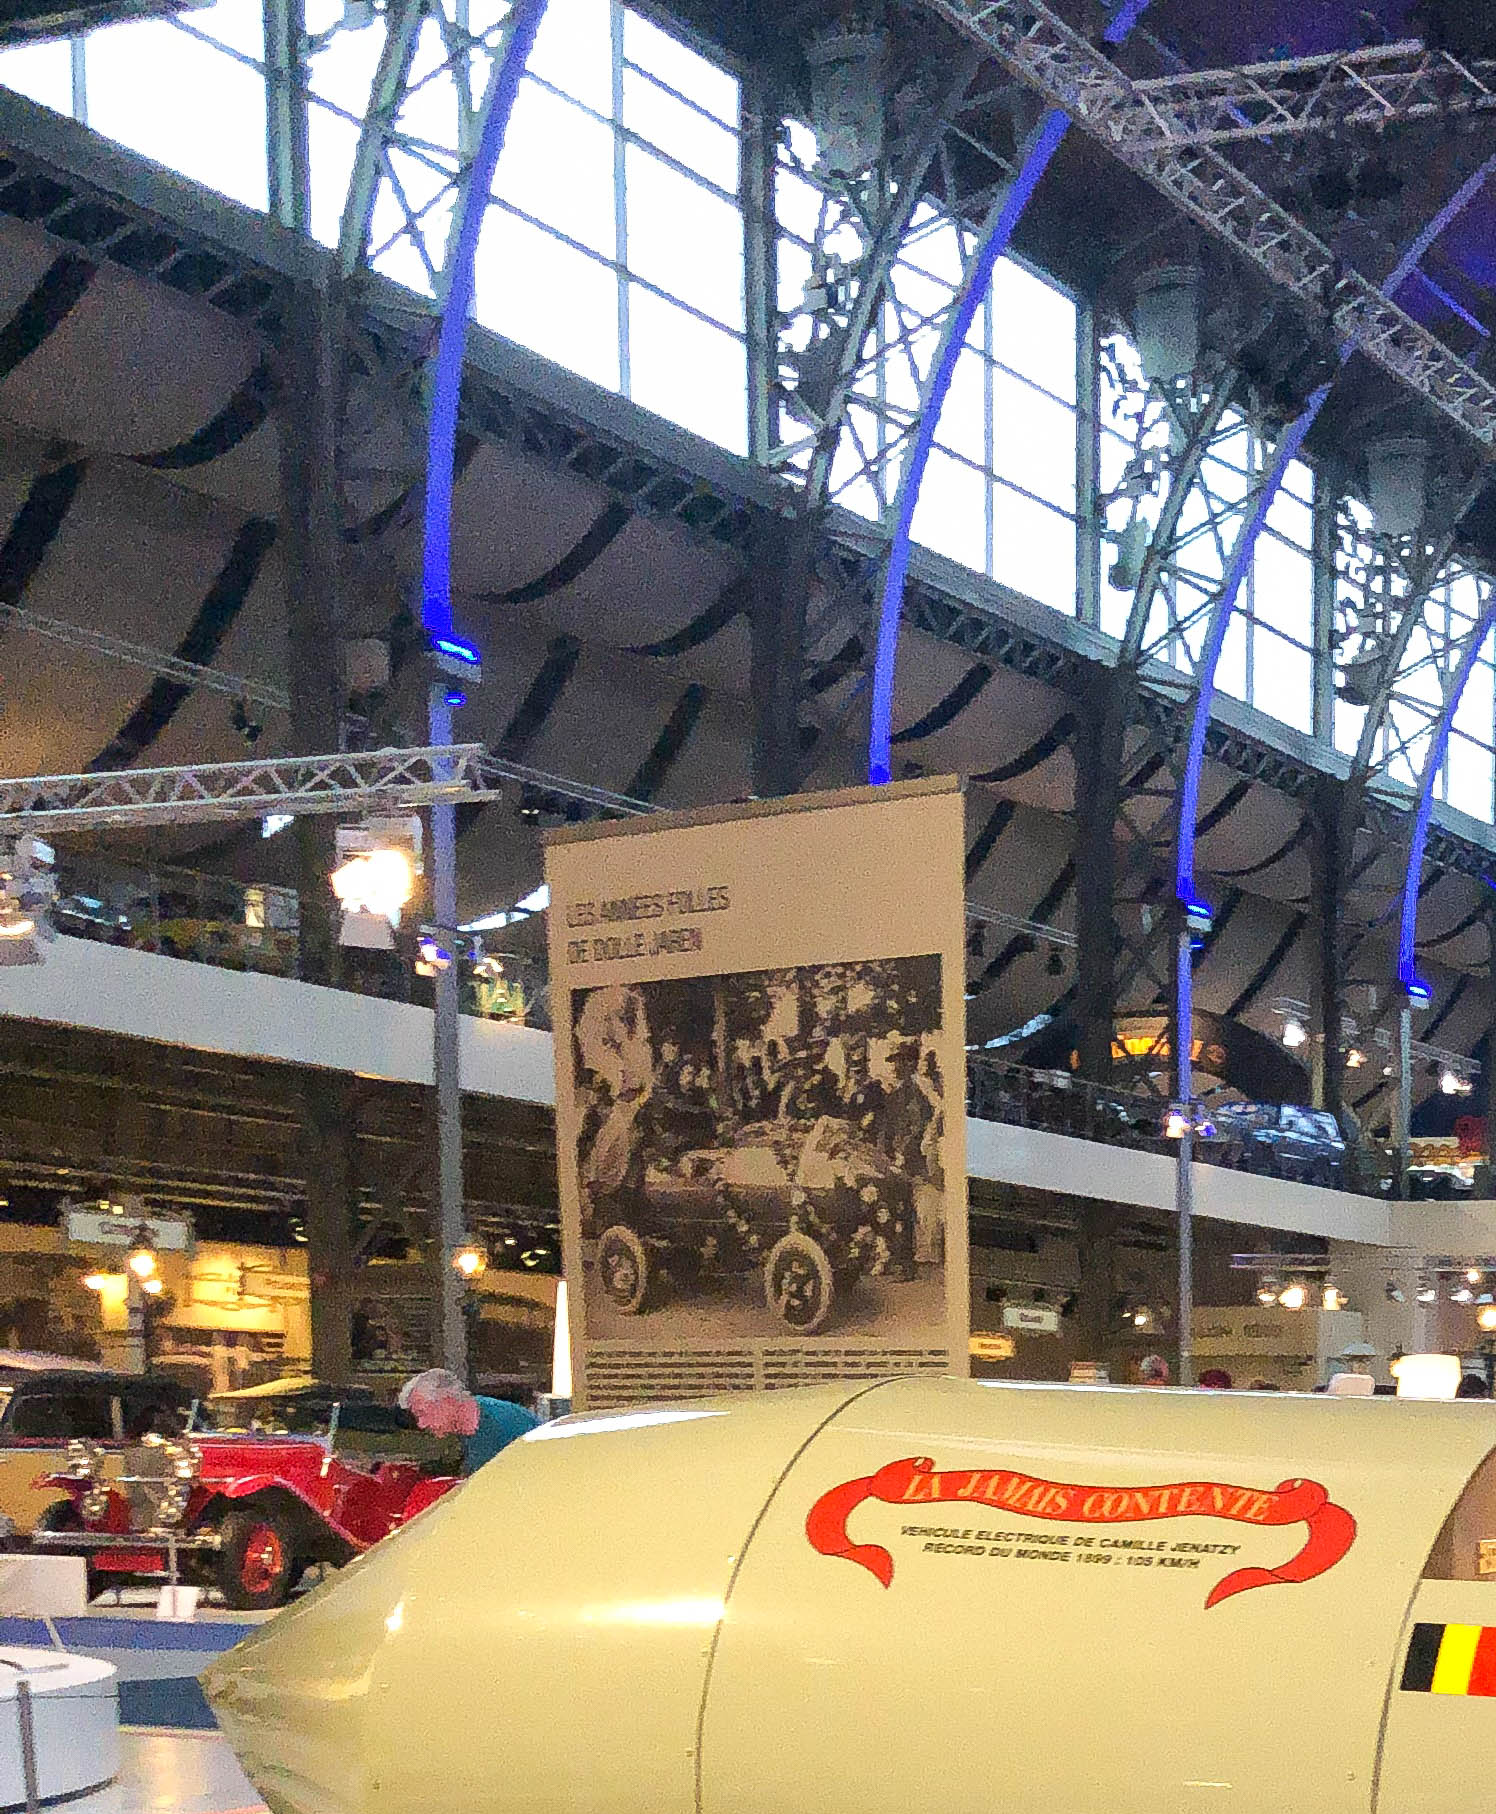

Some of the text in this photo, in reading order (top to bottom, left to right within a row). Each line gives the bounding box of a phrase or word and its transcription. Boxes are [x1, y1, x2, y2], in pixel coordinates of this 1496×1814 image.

[567, 902, 597, 928] LES
[668, 885, 731, 914] FOLLES
[567, 926, 703, 964] DE DOLLE JAREN
[903, 1472, 1280, 1521] LA JAMAIS CONTENTE
[901, 1525, 1242, 1555] VEHICULE ELECTRIQUE DE CAMILLE JENATZY
[922, 1542, 985, 1557] RECORD
[988, 1546, 1011, 1558] DU
[1014, 1548, 1072, 1562] MONDE
[1076, 1552, 1113, 1565] 1899
[1126, 1556, 1153, 1567] 105
[1156, 1556, 1201, 1569] KM/H
